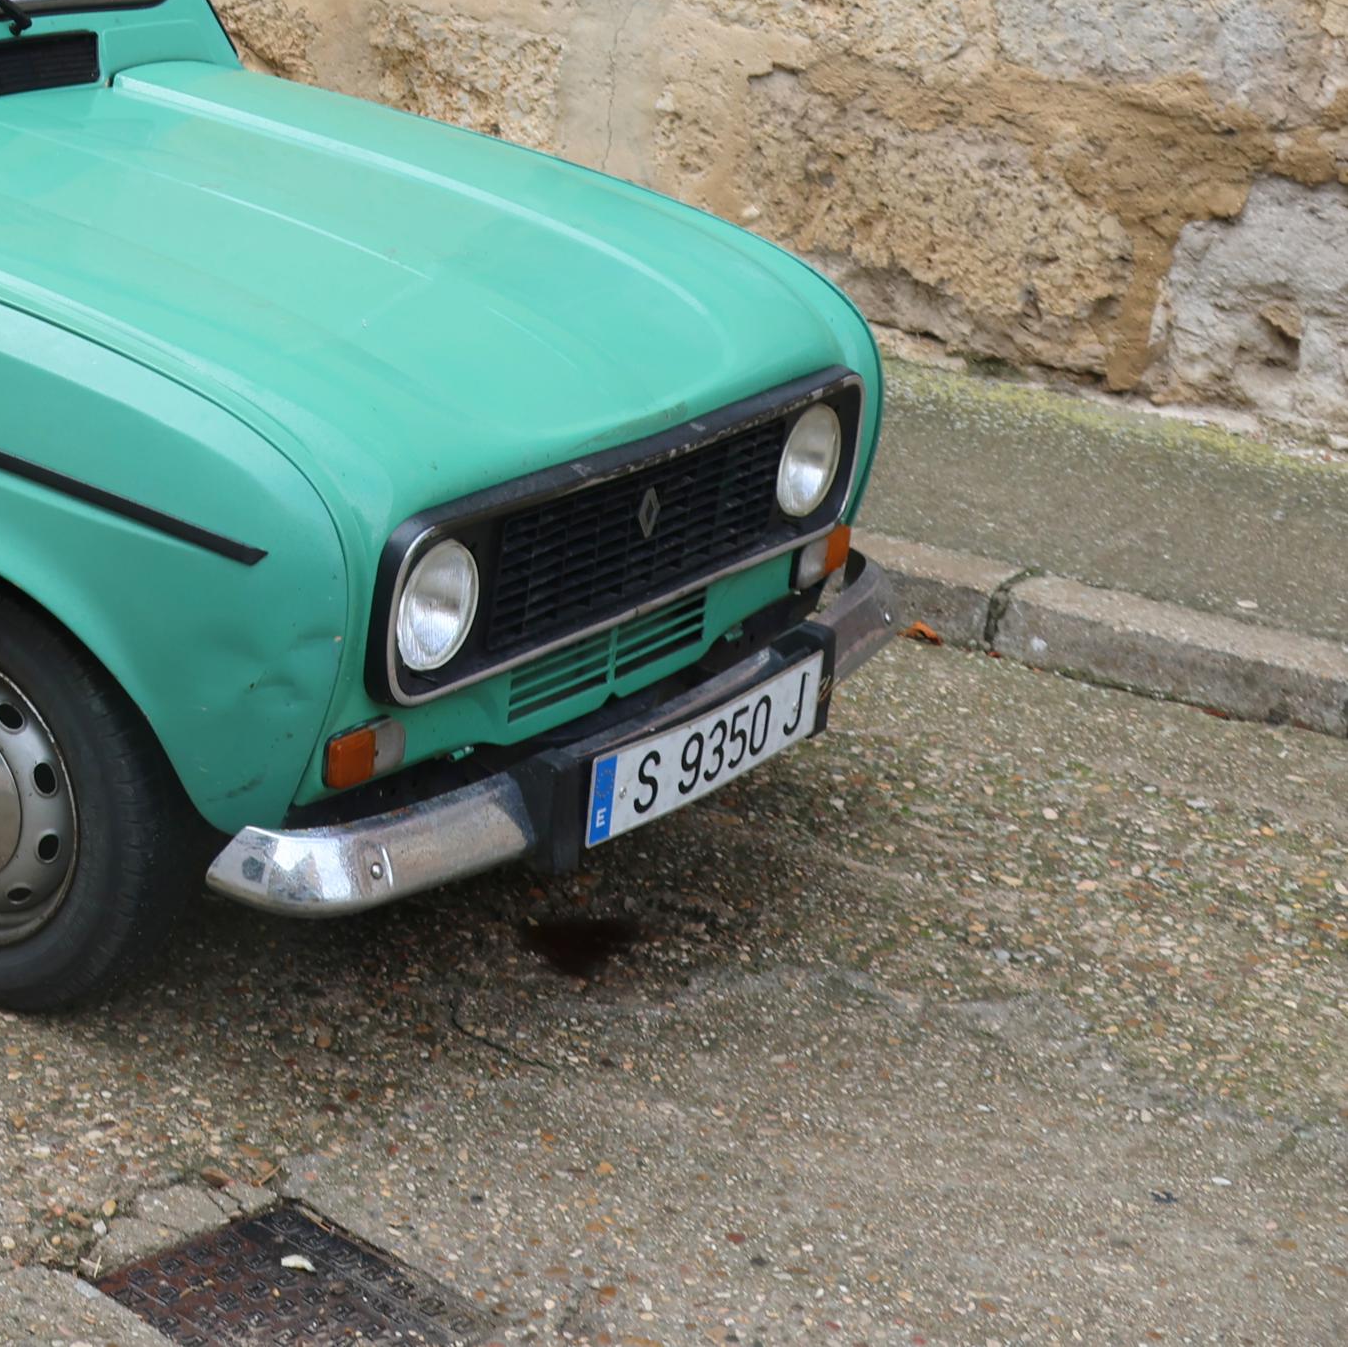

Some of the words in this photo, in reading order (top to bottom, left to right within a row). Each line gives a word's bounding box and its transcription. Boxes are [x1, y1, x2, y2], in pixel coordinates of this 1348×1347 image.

[633, 750, 662, 815] S
[678, 694, 772, 795] 9350
[783, 671, 810, 736] J
[596, 807, 607, 828] E
